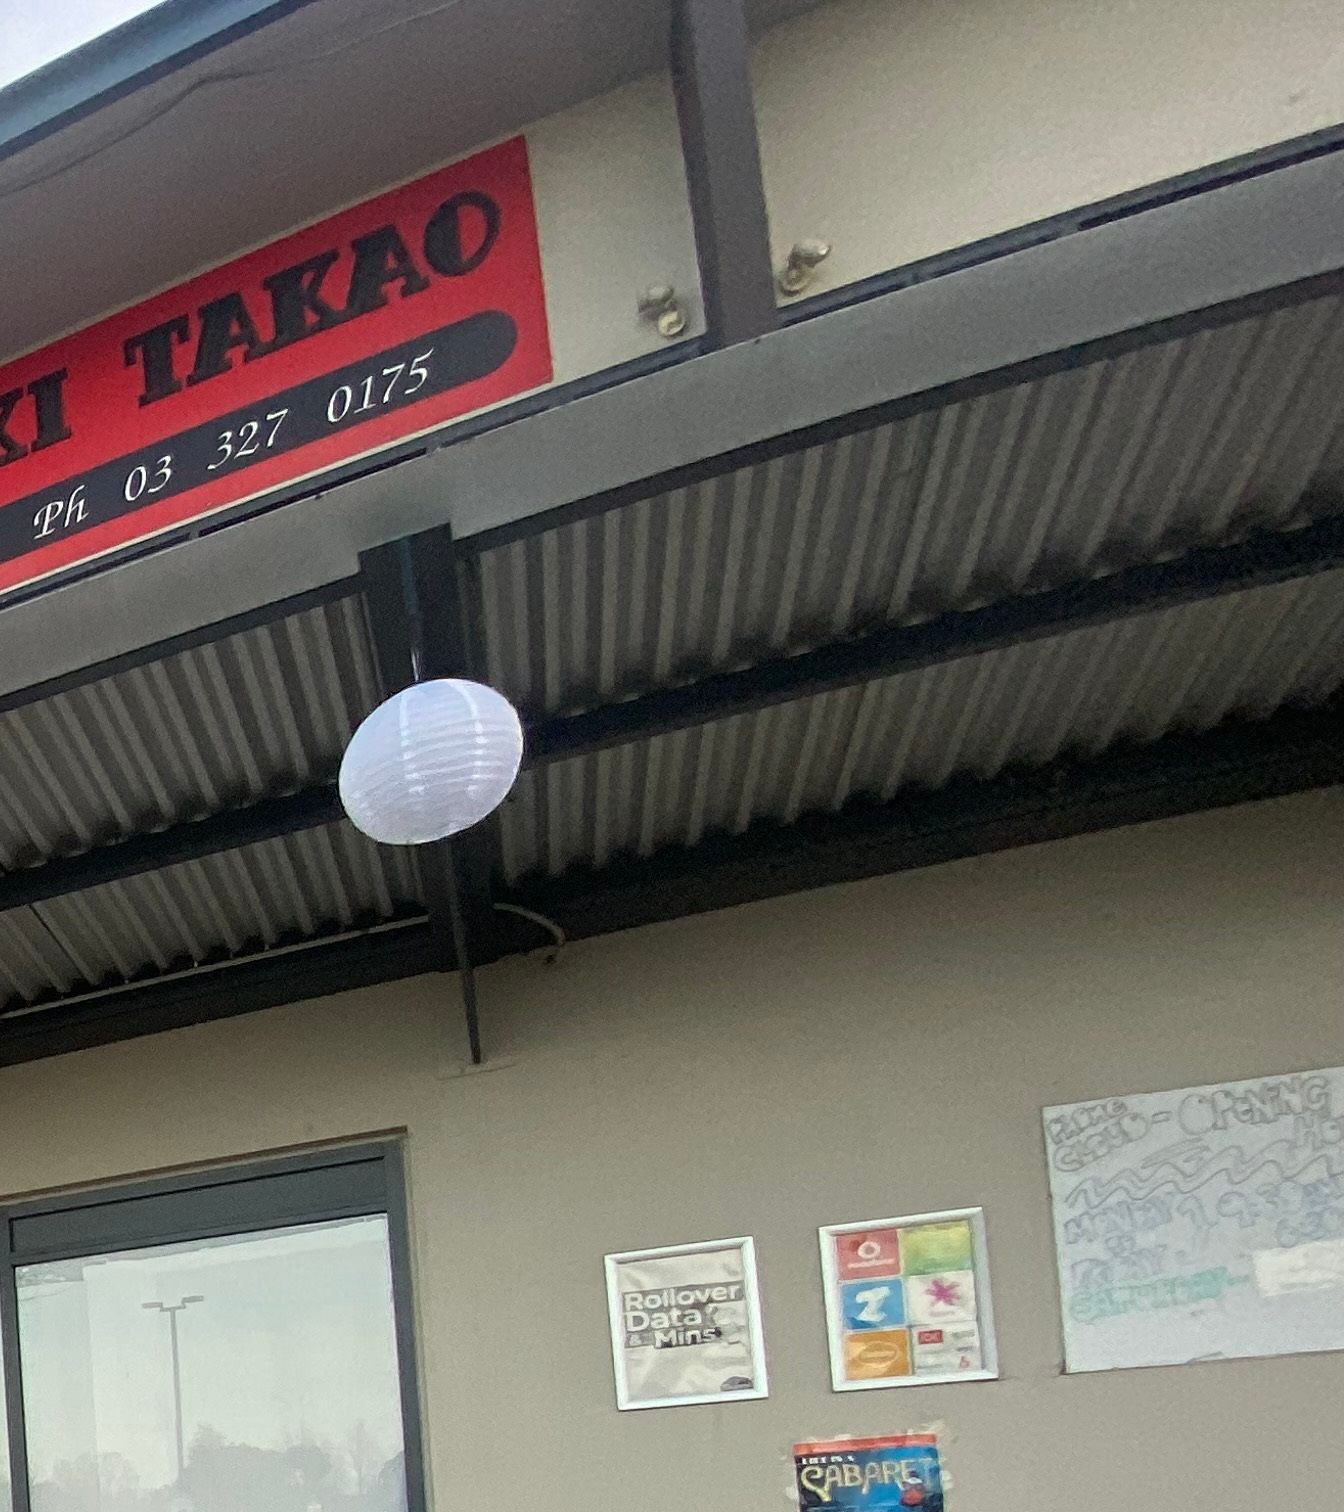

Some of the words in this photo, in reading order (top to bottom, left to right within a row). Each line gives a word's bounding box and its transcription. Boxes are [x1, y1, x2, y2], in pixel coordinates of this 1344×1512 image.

[123, 190, 501, 408] TAKAO
[32, 485, 89, 539] Ph
[123, 456, 173, 502] 03
[207, 409, 289, 471] 327
[326, 349, 434, 423] 0175
[625, 1285, 740, 1312] Rollover
[625, 1307, 702, 1332] Data
